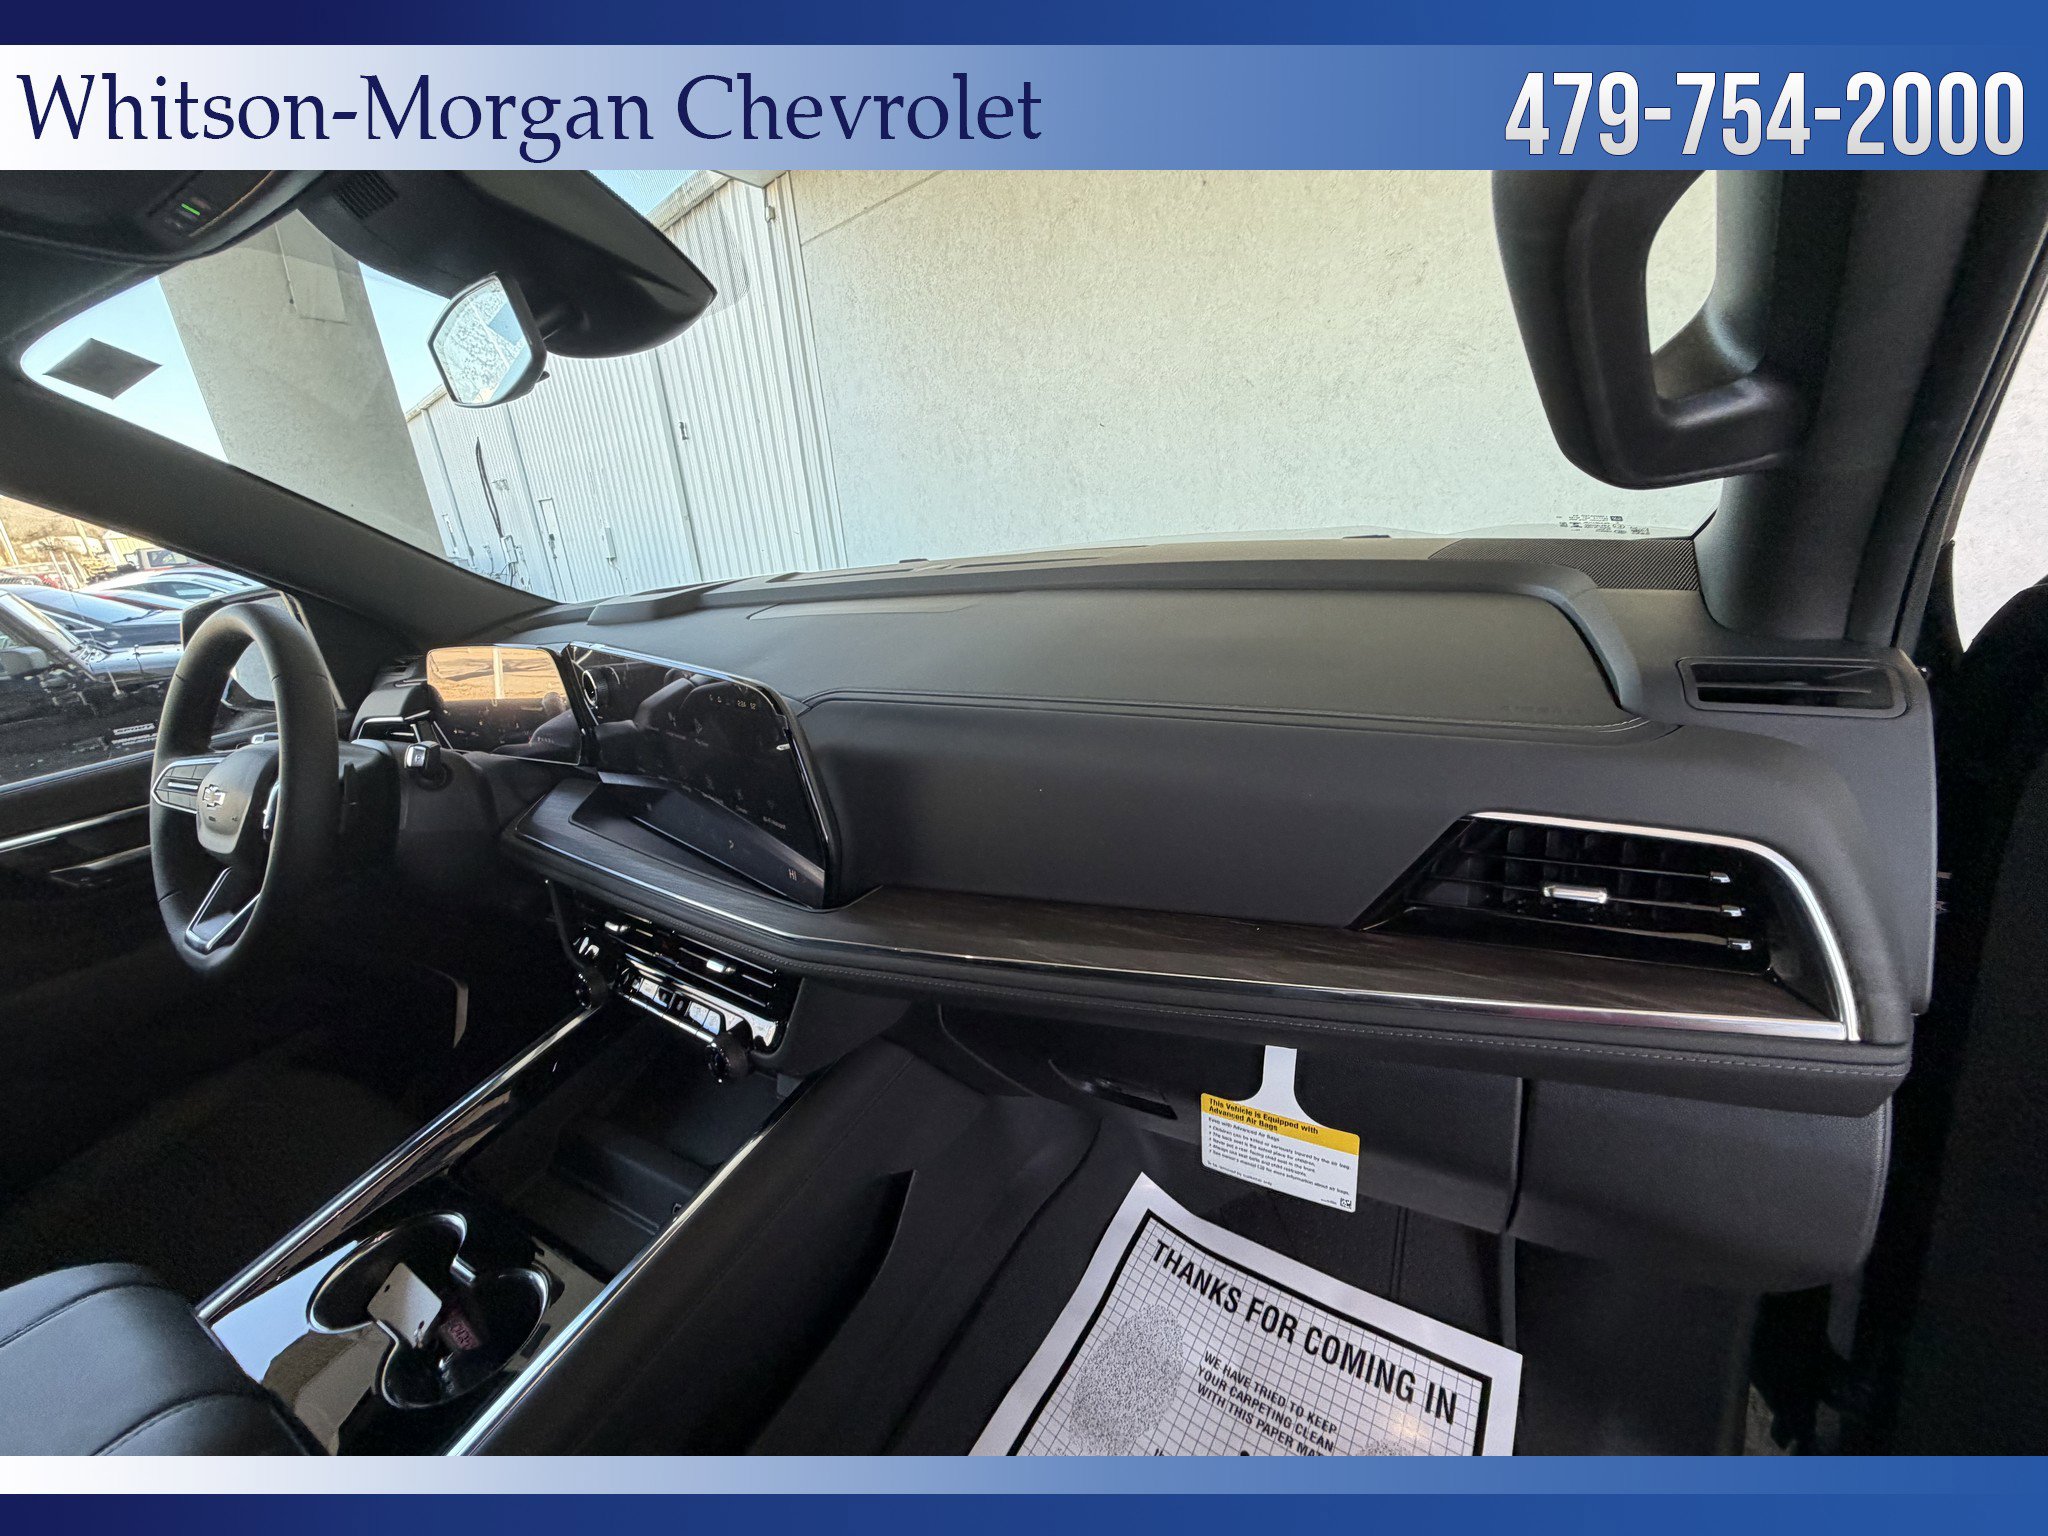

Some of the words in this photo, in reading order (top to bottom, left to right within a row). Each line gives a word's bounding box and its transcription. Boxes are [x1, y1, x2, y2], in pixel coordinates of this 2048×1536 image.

[1209, 1098, 1224, 1108] This
[1226, 1103, 1252, 1116] Vehicle
[1264, 1114, 1298, 1129] Equipped
[1301, 1124, 1318, 1134] with
[1209, 1106, 1244, 1120] Advanced
[1246, 1116, 1256, 1125] Air
[1259, 1120, 1278, 1131] Bags
[1152, 1239, 1242, 1313] THANKS
[1245, 1296, 1298, 1344] FOR
[1303, 1326, 1417, 1404] COMING
[1424, 1381, 1458, 1425] IN
[1198, 1364, 1228, 1392] YOUR
[1229, 1386, 1292, 1429] CARPETING
[1294, 1422, 1334, 1452] CLEAN
[1198, 1382, 1226, 1408] WITH
[1228, 1400, 1253, 1425] THIS
[1256, 1419, 1294, 1449] PAPER
[1204, 1350, 1221, 1370] WE
[1223, 1362, 1250, 1388] HAVE
[1253, 1381, 1287, 1407] TRIED
[1289, 1400, 1304, 1418] TO
[1306, 1411, 1338, 1434] KEEP
